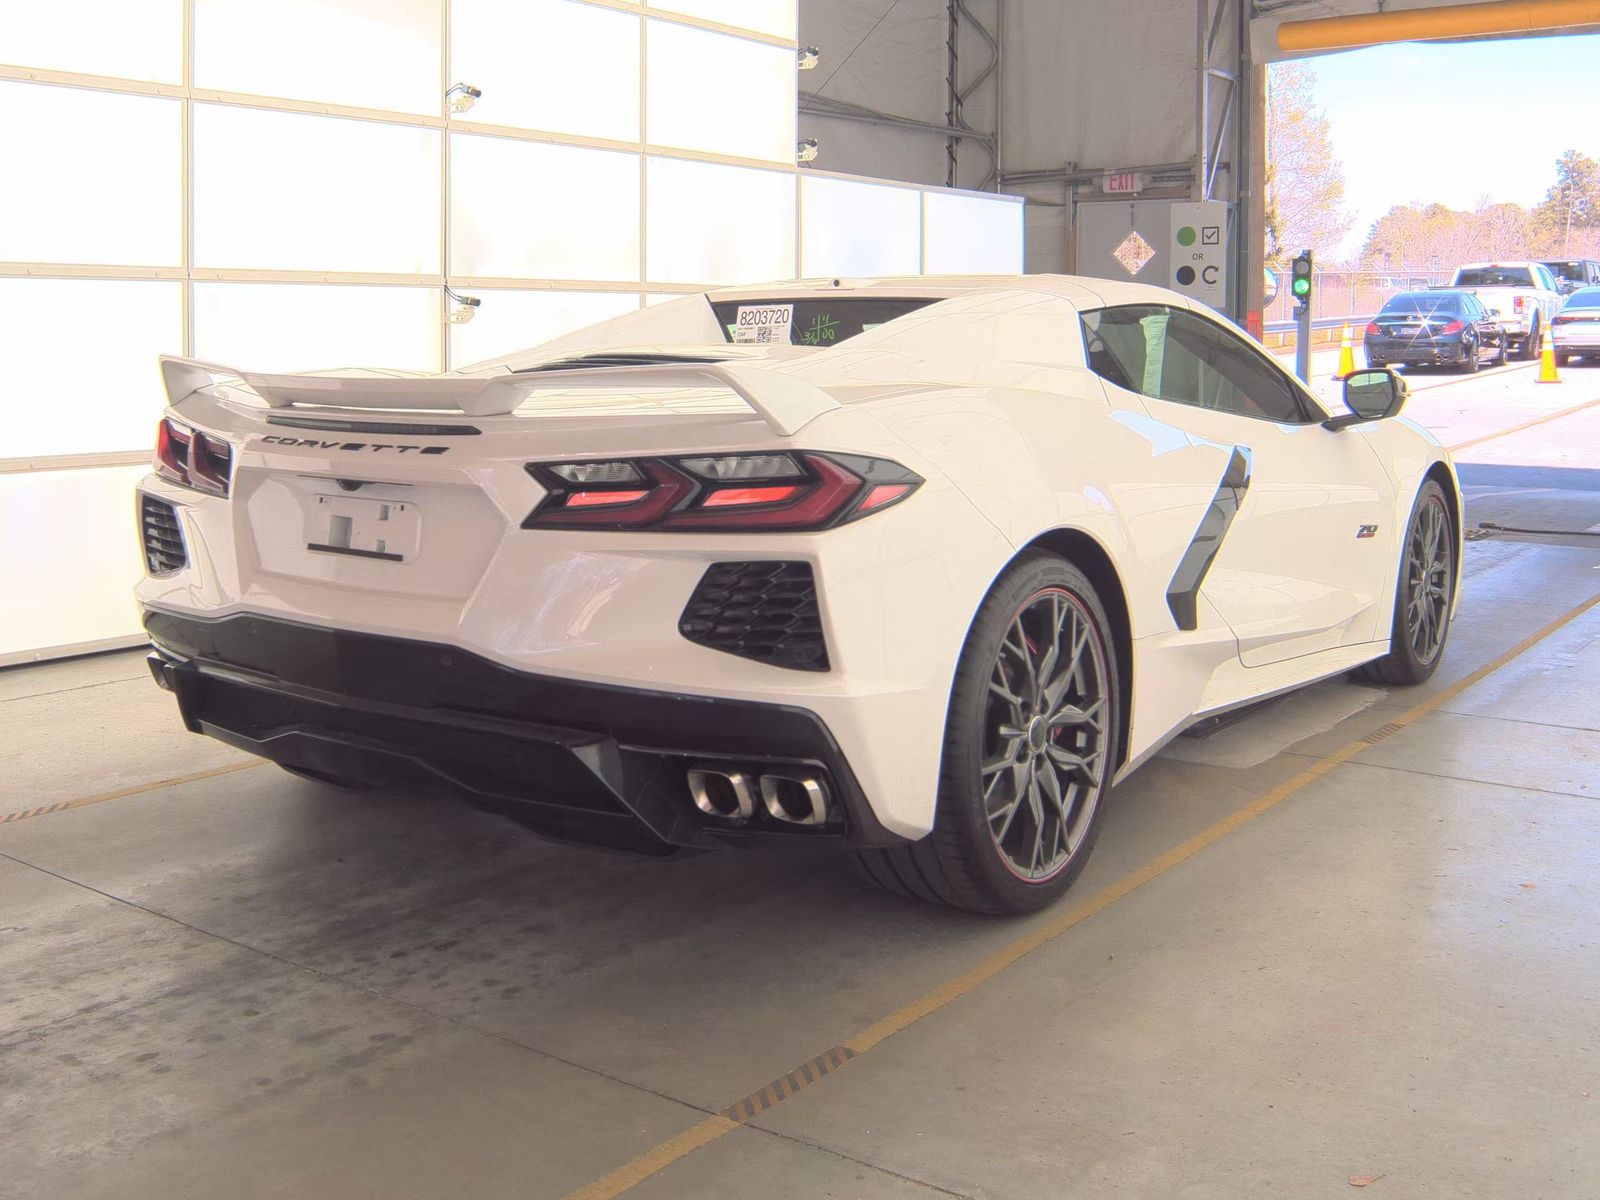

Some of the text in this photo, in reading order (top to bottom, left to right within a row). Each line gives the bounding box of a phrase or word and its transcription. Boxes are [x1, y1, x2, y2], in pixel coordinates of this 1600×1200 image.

[1109, 173, 1135, 191] EXIT
[1192, 253, 1204, 261] OR
[740, 308, 790, 326] 8203720
[261, 435, 450, 455] CORVETTE
